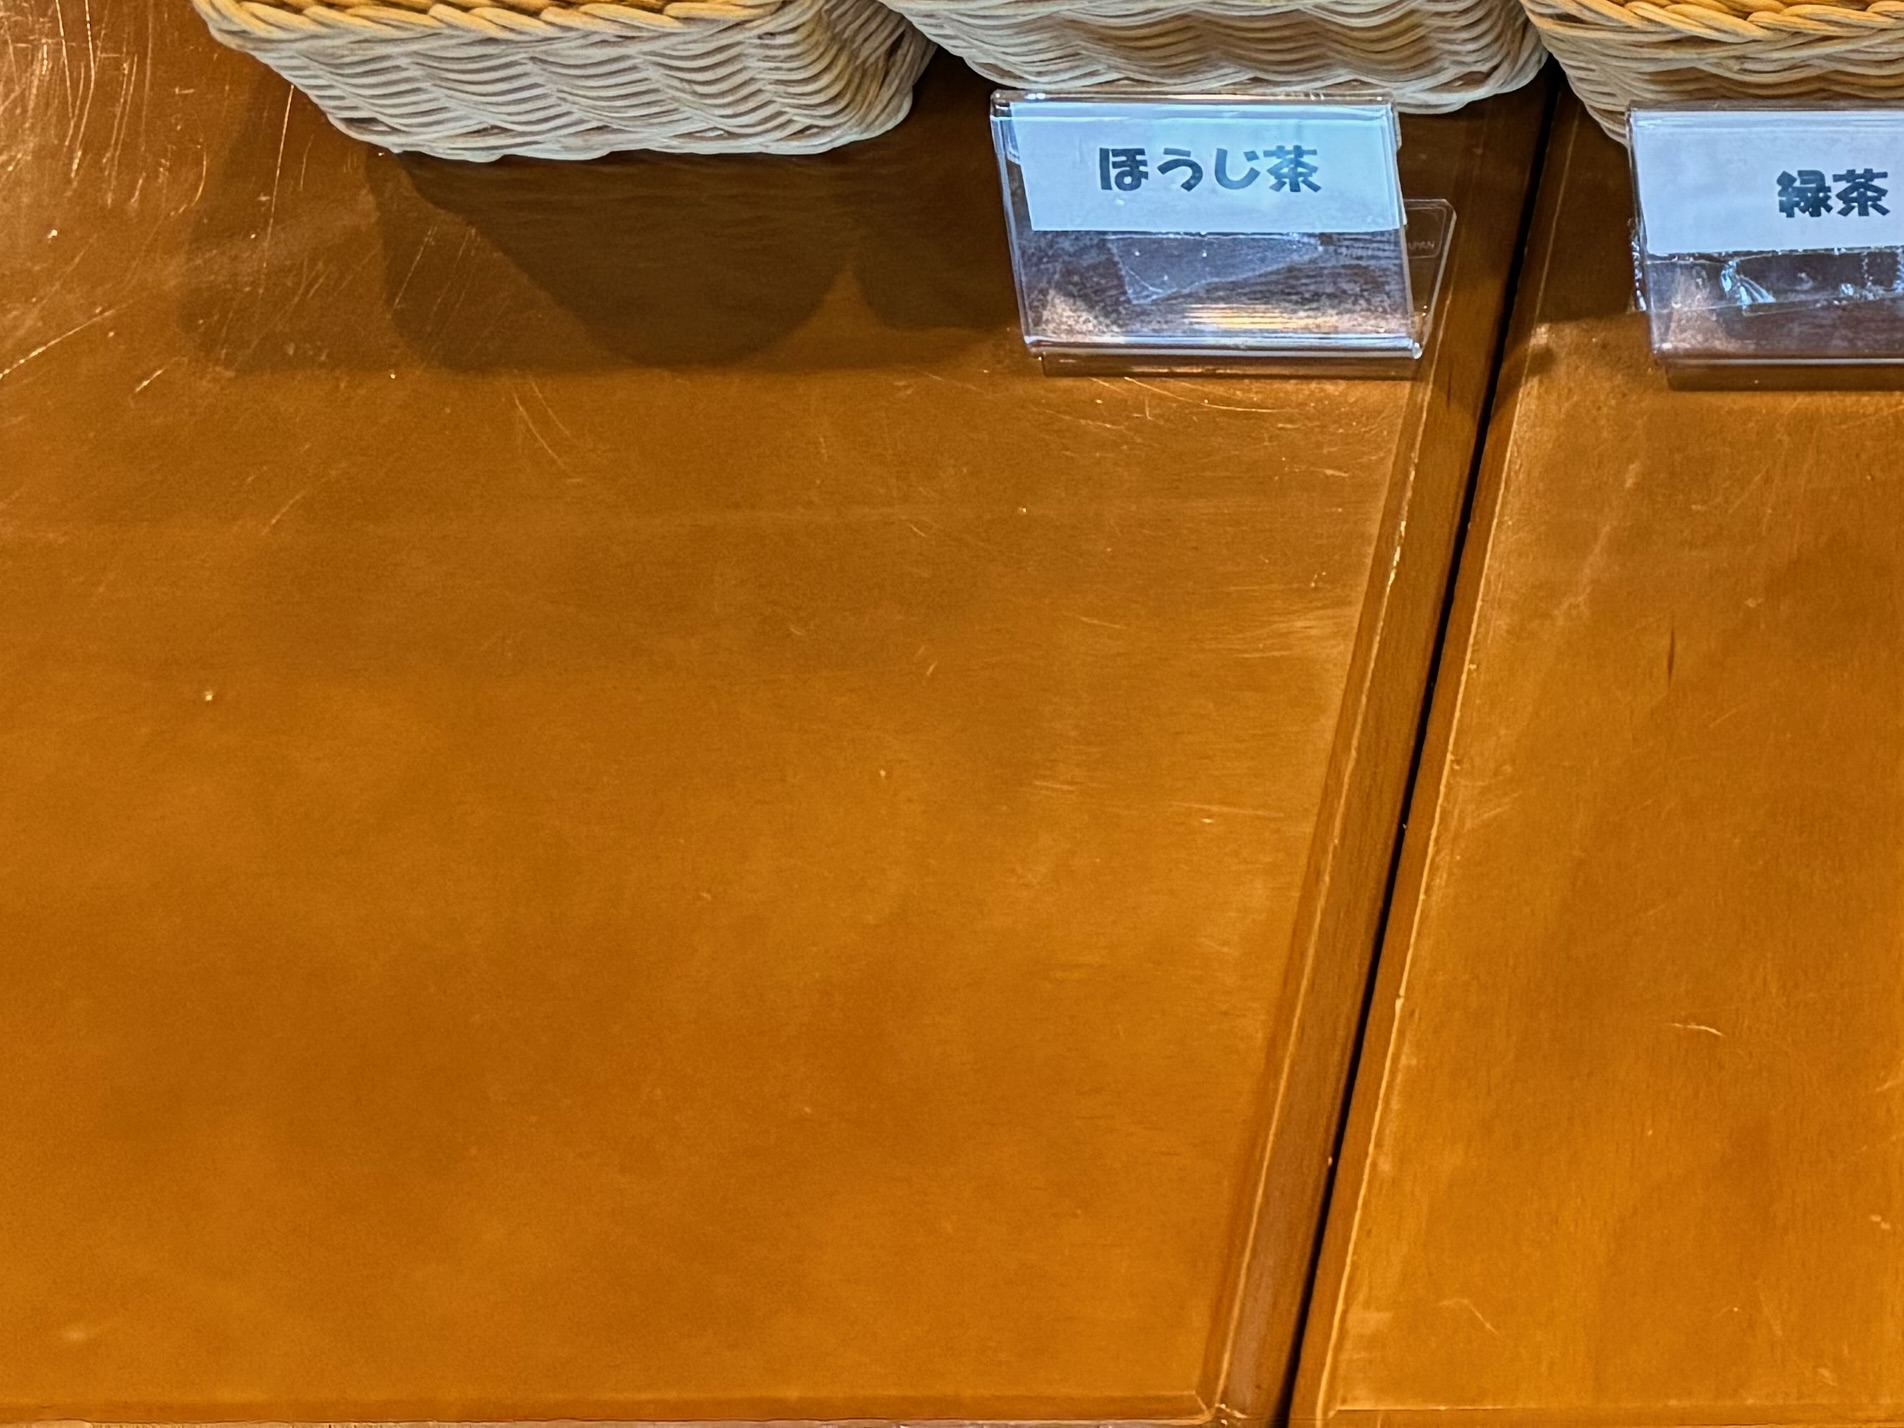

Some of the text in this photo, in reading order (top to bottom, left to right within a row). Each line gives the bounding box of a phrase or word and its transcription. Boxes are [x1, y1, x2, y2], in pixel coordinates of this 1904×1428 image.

[1097, 144, 1324, 194] ほうじ茶
[1775, 168, 1891, 220] 緑茶
